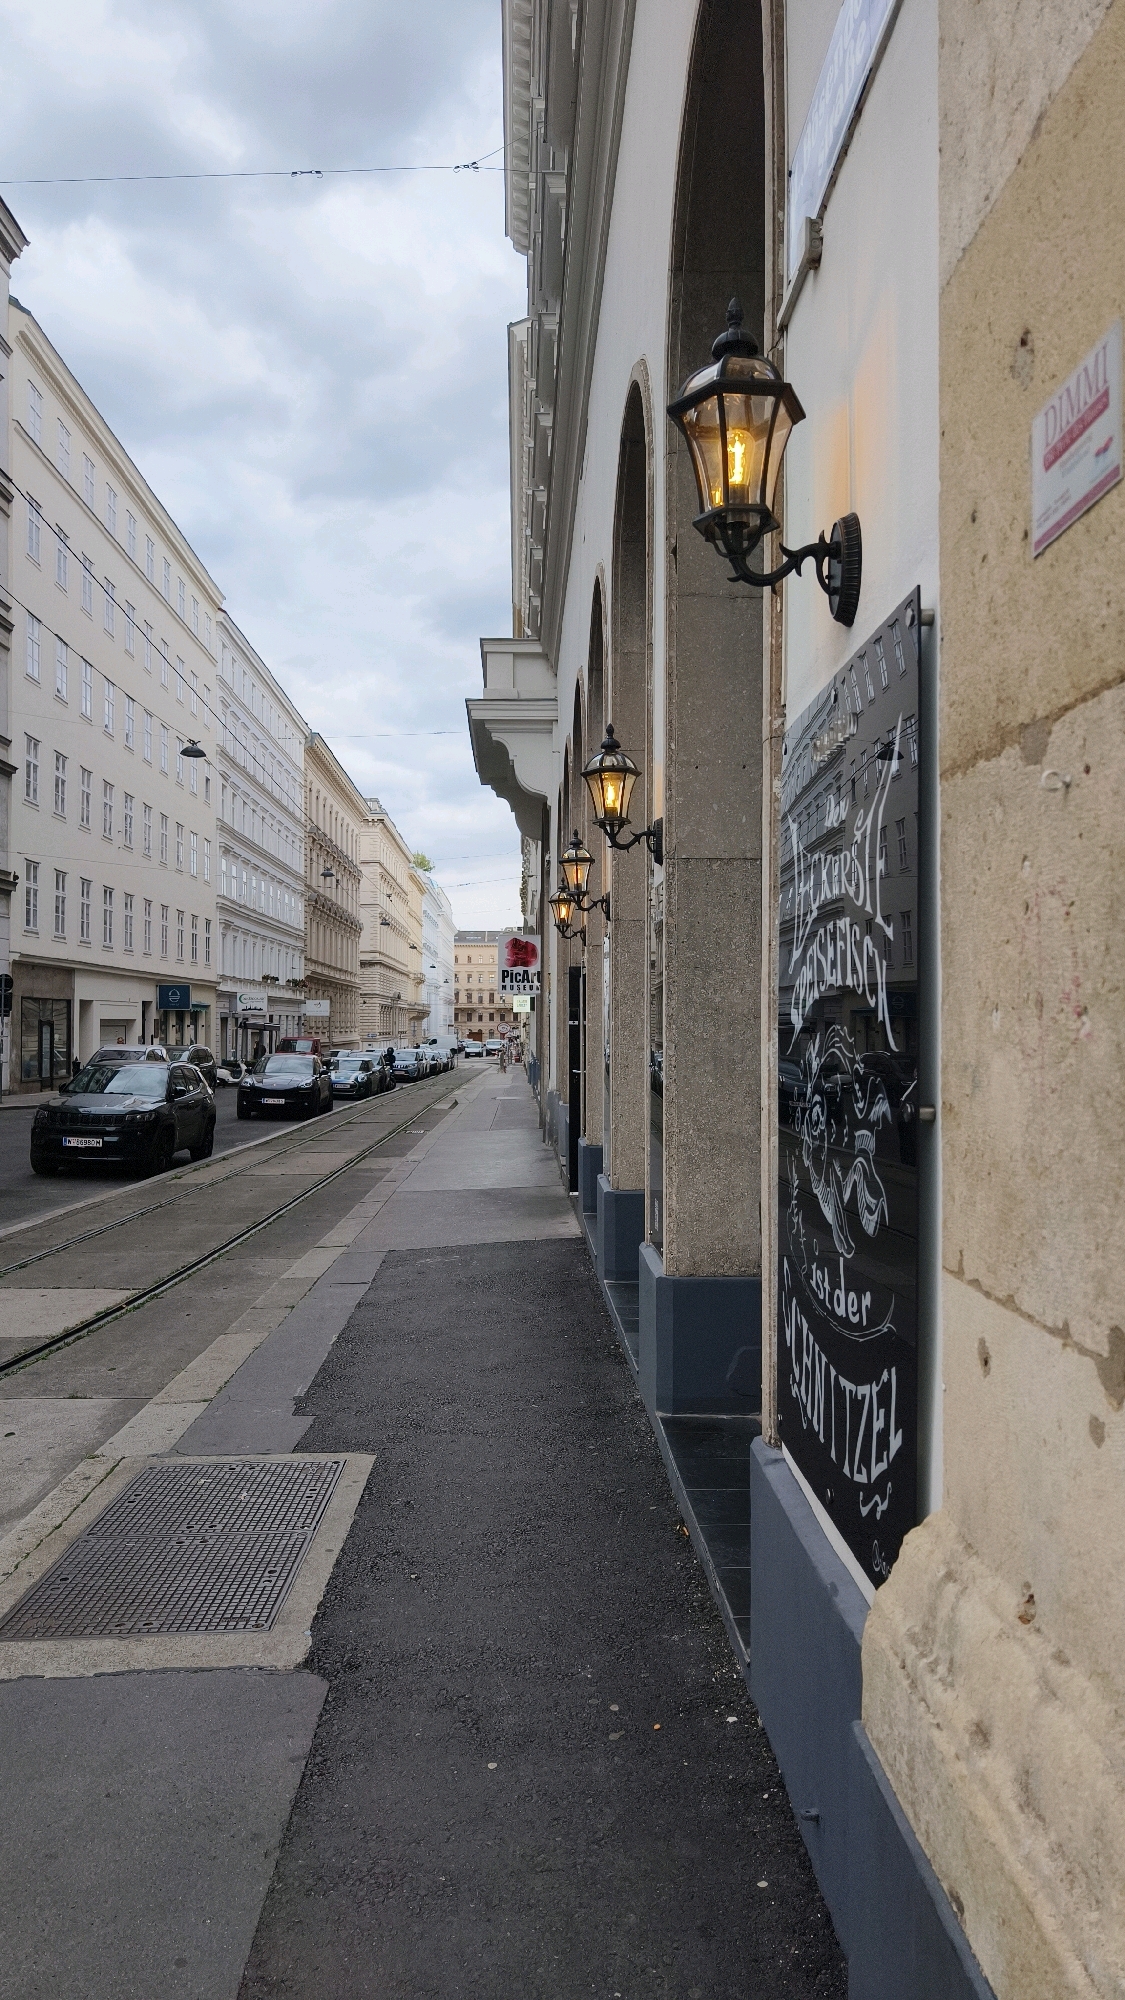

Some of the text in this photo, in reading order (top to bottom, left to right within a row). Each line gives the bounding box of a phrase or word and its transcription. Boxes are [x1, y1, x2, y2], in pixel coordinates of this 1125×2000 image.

[817, 20, 867, 178] straße
[1044, 343, 1109, 448] DIMMI
[824, 794, 850, 827] Der
[786, 916, 900, 1056] SPEISEFISCH
[810, 1239, 872, 1327] ist der
[782, 1256, 903, 1484] SCHNITZEL
